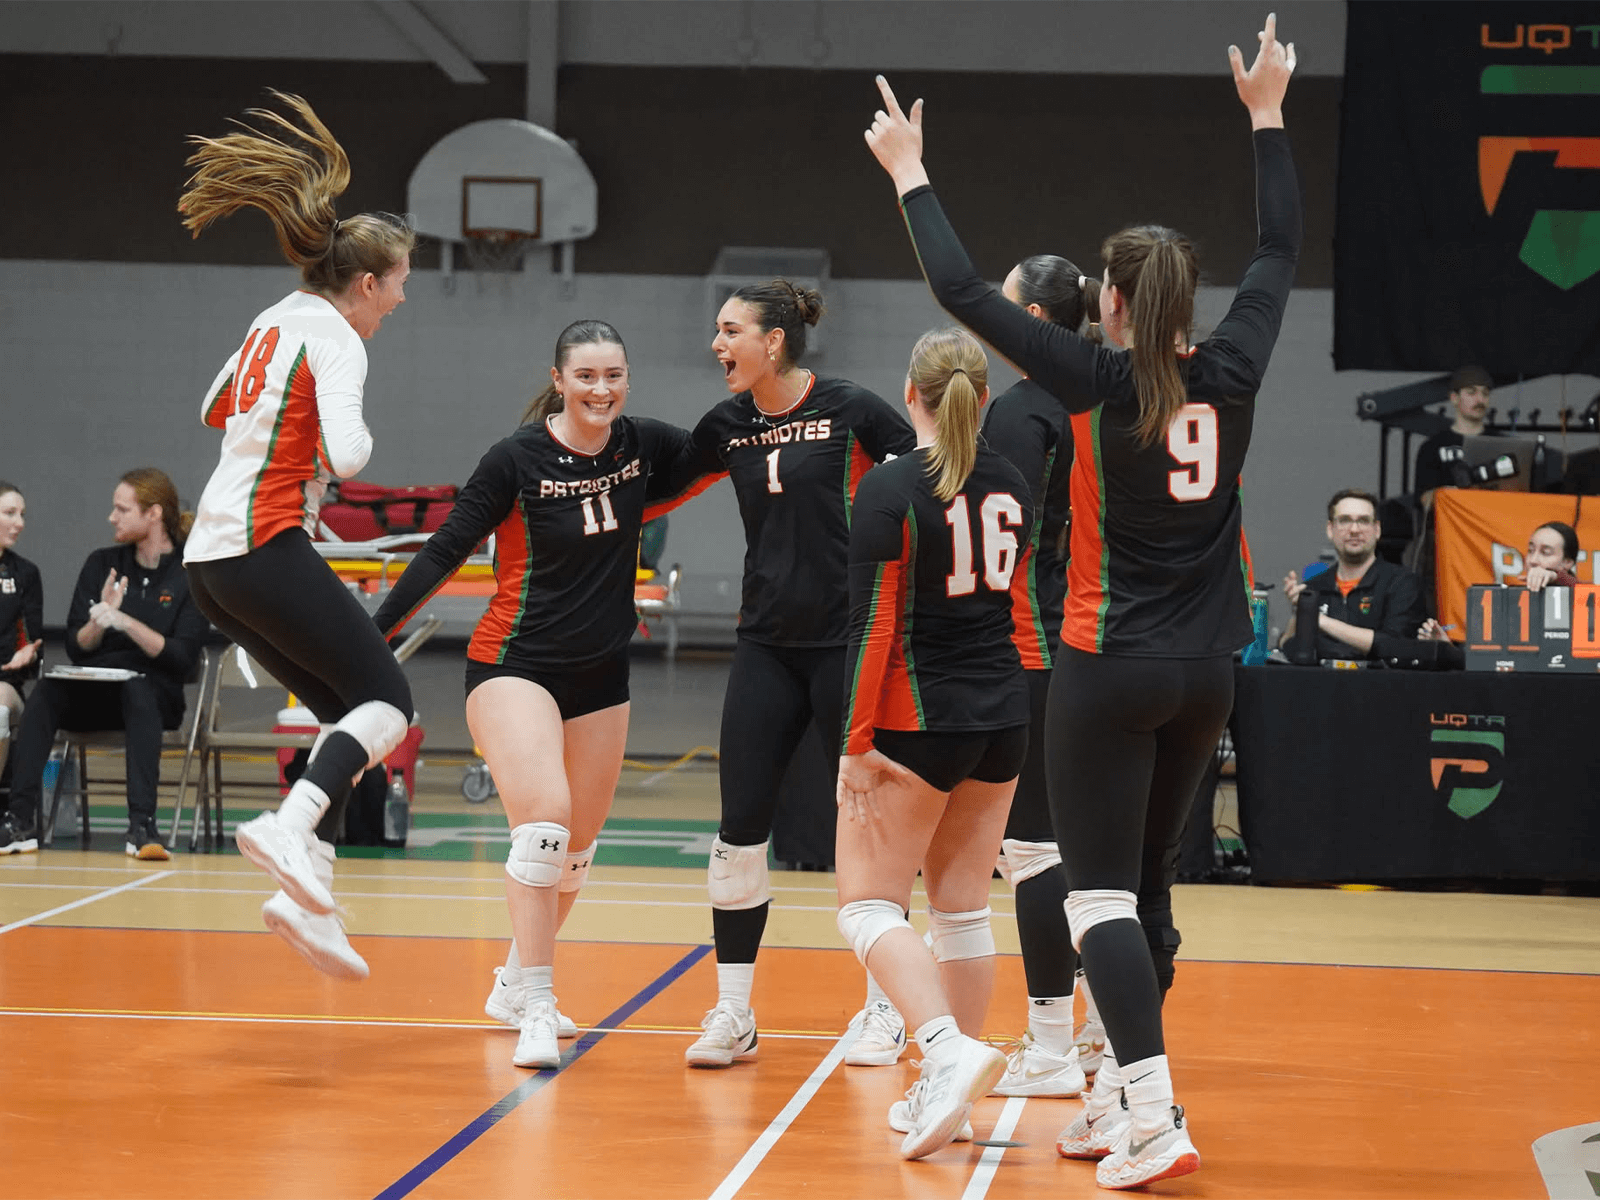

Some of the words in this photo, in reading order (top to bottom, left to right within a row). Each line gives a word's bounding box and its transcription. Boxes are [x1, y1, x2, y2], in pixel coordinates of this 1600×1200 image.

[225, 326, 281, 417] 18
[765, 447, 784, 495] 1
[1166, 402, 1221, 503] 9
[580, 489, 619, 537] 11
[944, 492, 1024, 598] 16
[1552, 586, 1562, 620] 1
[1543, 631, 1570, 640] PERIOD
[1429, 712, 1506, 727] UQTR
